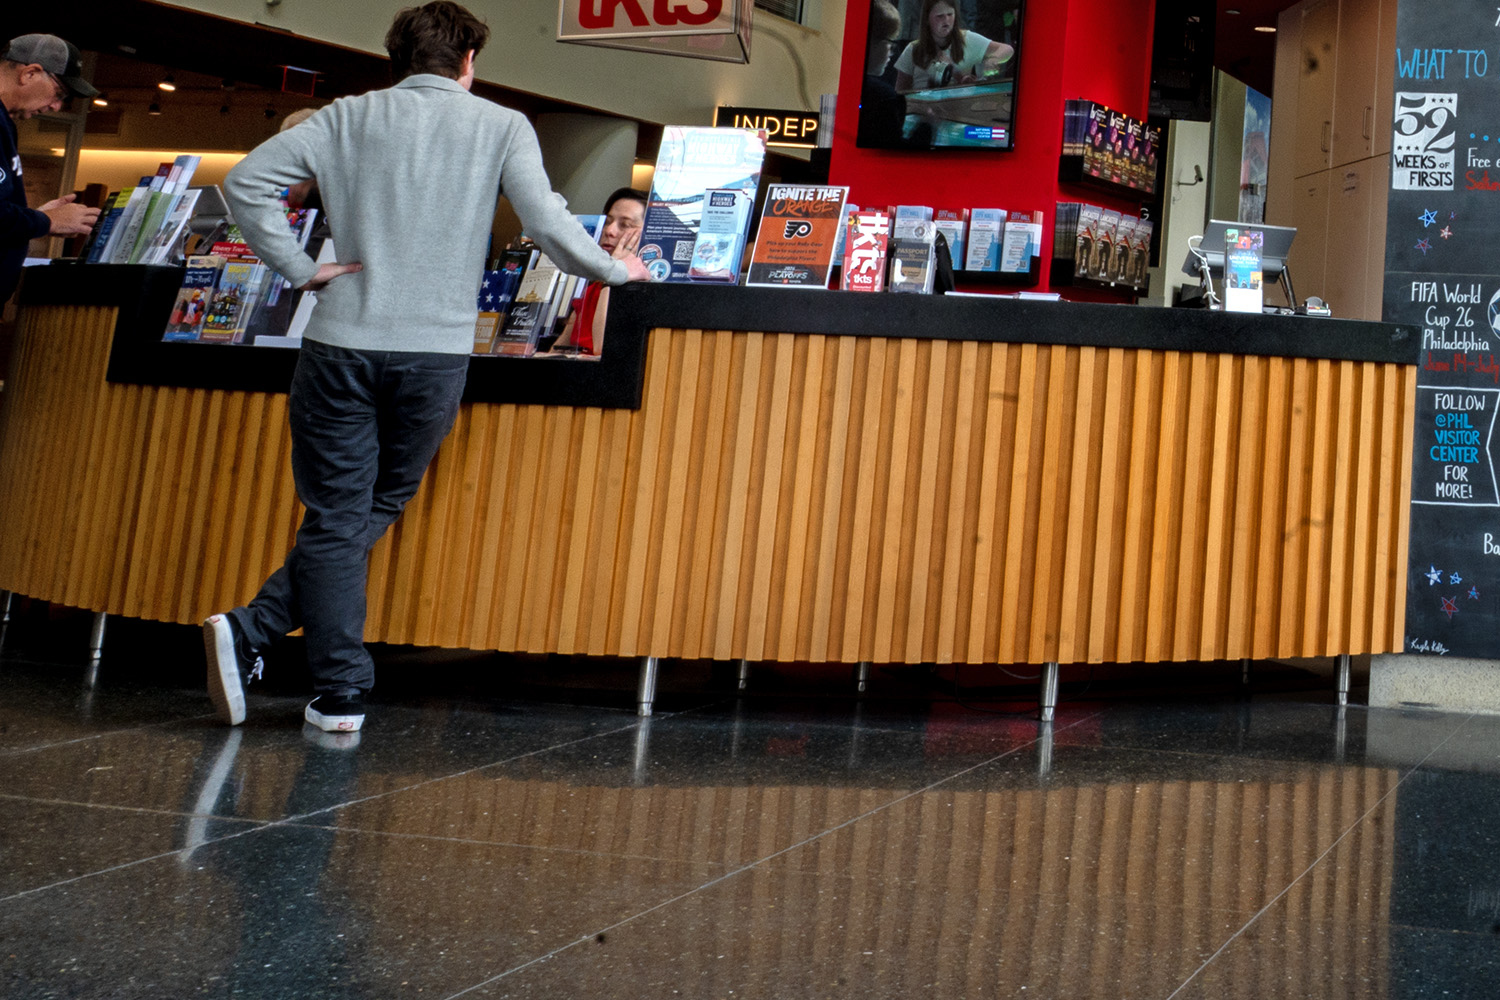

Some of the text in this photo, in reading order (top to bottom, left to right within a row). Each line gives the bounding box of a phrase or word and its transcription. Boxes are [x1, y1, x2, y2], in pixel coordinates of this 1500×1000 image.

[1396, 48, 1453, 79] WHAT
[1457, 49, 1488, 79] TO
[1393, 94, 1457, 154] 52
[1394, 154, 1437, 169] WEEKS
[1467, 147, 1491, 168] Free
[1409, 171, 1453, 187] FIRSTS
[771, 187, 841, 202] IGNITE THE
[772, 197, 834, 217] ORANGE
[768, 270, 808, 279] PLAYOFFS
[853, 274, 873, 284] tkts
[1411, 281, 1481, 304] FIFA World
[1425, 305, 1475, 330] Cup 26
[1423, 328, 1490, 354] Philadelphia
[1424, 352, 1450, 372] June
[1434, 393, 1486, 411] FOLLOW
[1435, 413, 1473, 429] @PHL
[1434, 430, 1481, 445] VISITOR
[1429, 445, 1479, 464] CENTER
[1444, 465, 1468, 482] FOR
[1435, 482, 1473, 499] MORE!
